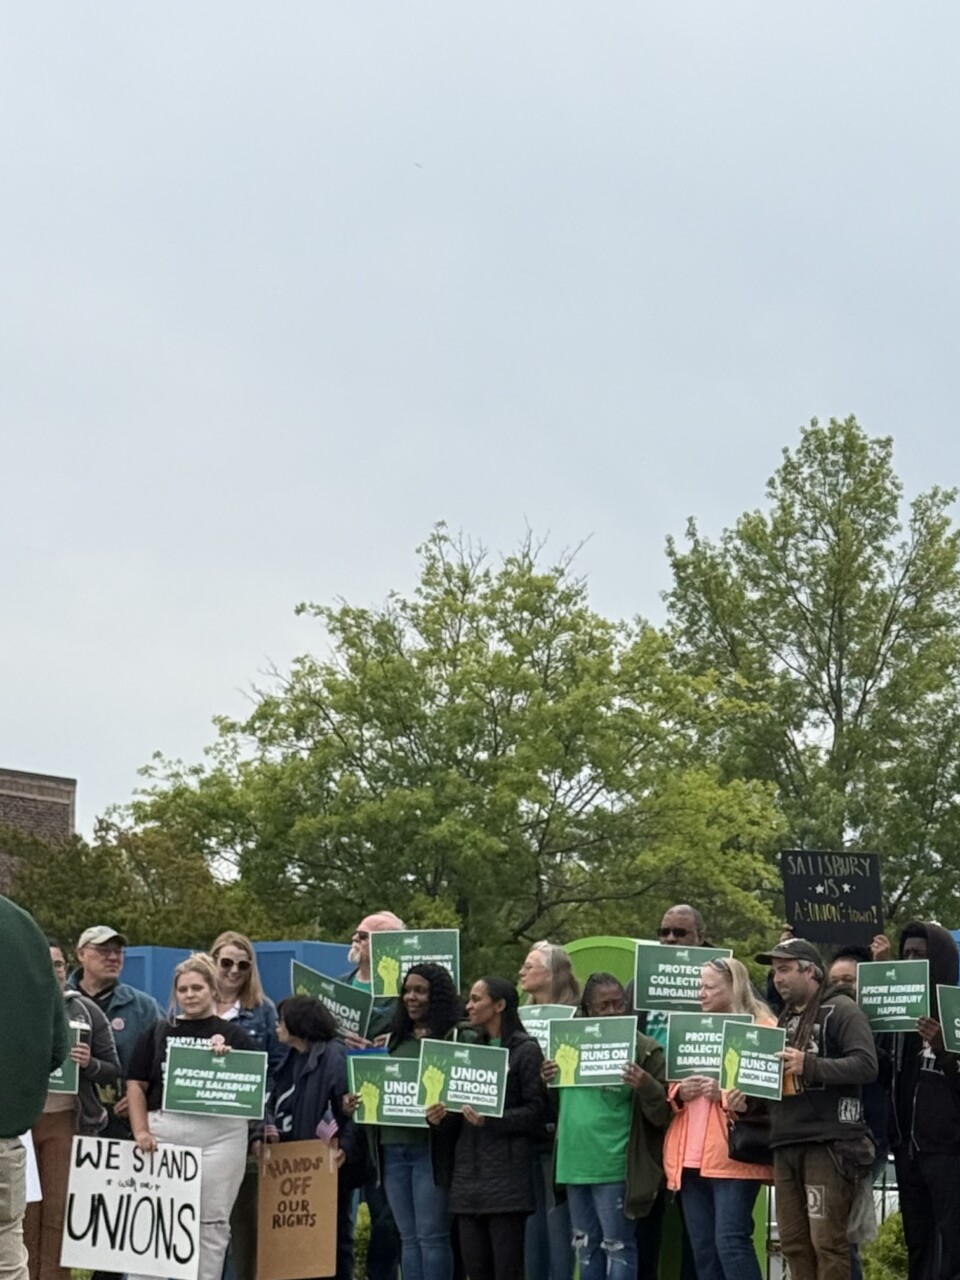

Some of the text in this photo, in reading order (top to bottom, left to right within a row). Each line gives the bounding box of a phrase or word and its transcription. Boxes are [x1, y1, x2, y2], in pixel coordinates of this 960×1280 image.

[824, 878, 840, 898] IS
[794, 901, 803, 920] A
[650, 976, 701, 987] COLLECTI
[648, 986, 701, 998] BARGAINI
[861, 984, 926, 995] AFSCME MEMBERS
[862, 995, 923, 1005] MAKE SALISBURY
[877, 1005, 907, 1015] HAPPEN
[684, 1032, 723, 1043] PROTEC
[581, 1049, 628, 1061] RUNS ON
[679, 1044, 723, 1055] COLLECTI
[581, 1063, 625, 1072] UNION LABO
[677, 1056, 721, 1067] BARGAINI
[740, 1057, 780, 1073] RUNS ON
[173, 1067, 216, 1079] AFSCME
[216, 1071, 262, 1083] MEMBERS
[451, 1066, 498, 1084] UNION
[741, 1072, 760, 1081] UNION
[174, 1077, 258, 1093] MAKE SALISBURY
[384, 1081, 418, 1095] UNIO
[449, 1080, 498, 1095] STRONG
[195, 1089, 237, 1101] HAPPEN
[384, 1094, 418, 1106] STRO
[450, 1093, 496, 1105] UNION PROUD
[385, 1107, 404, 1115] UNION
[75, 1139, 198, 1182] WE STAND
[268, 1157, 324, 1178] HANDS
[280, 1177, 312, 1196] OFF
[278, 1200, 310, 1213] OUR
[272, 1213, 317, 1229] RIGHTS
[67, 1193, 196, 1264] UNIONS
